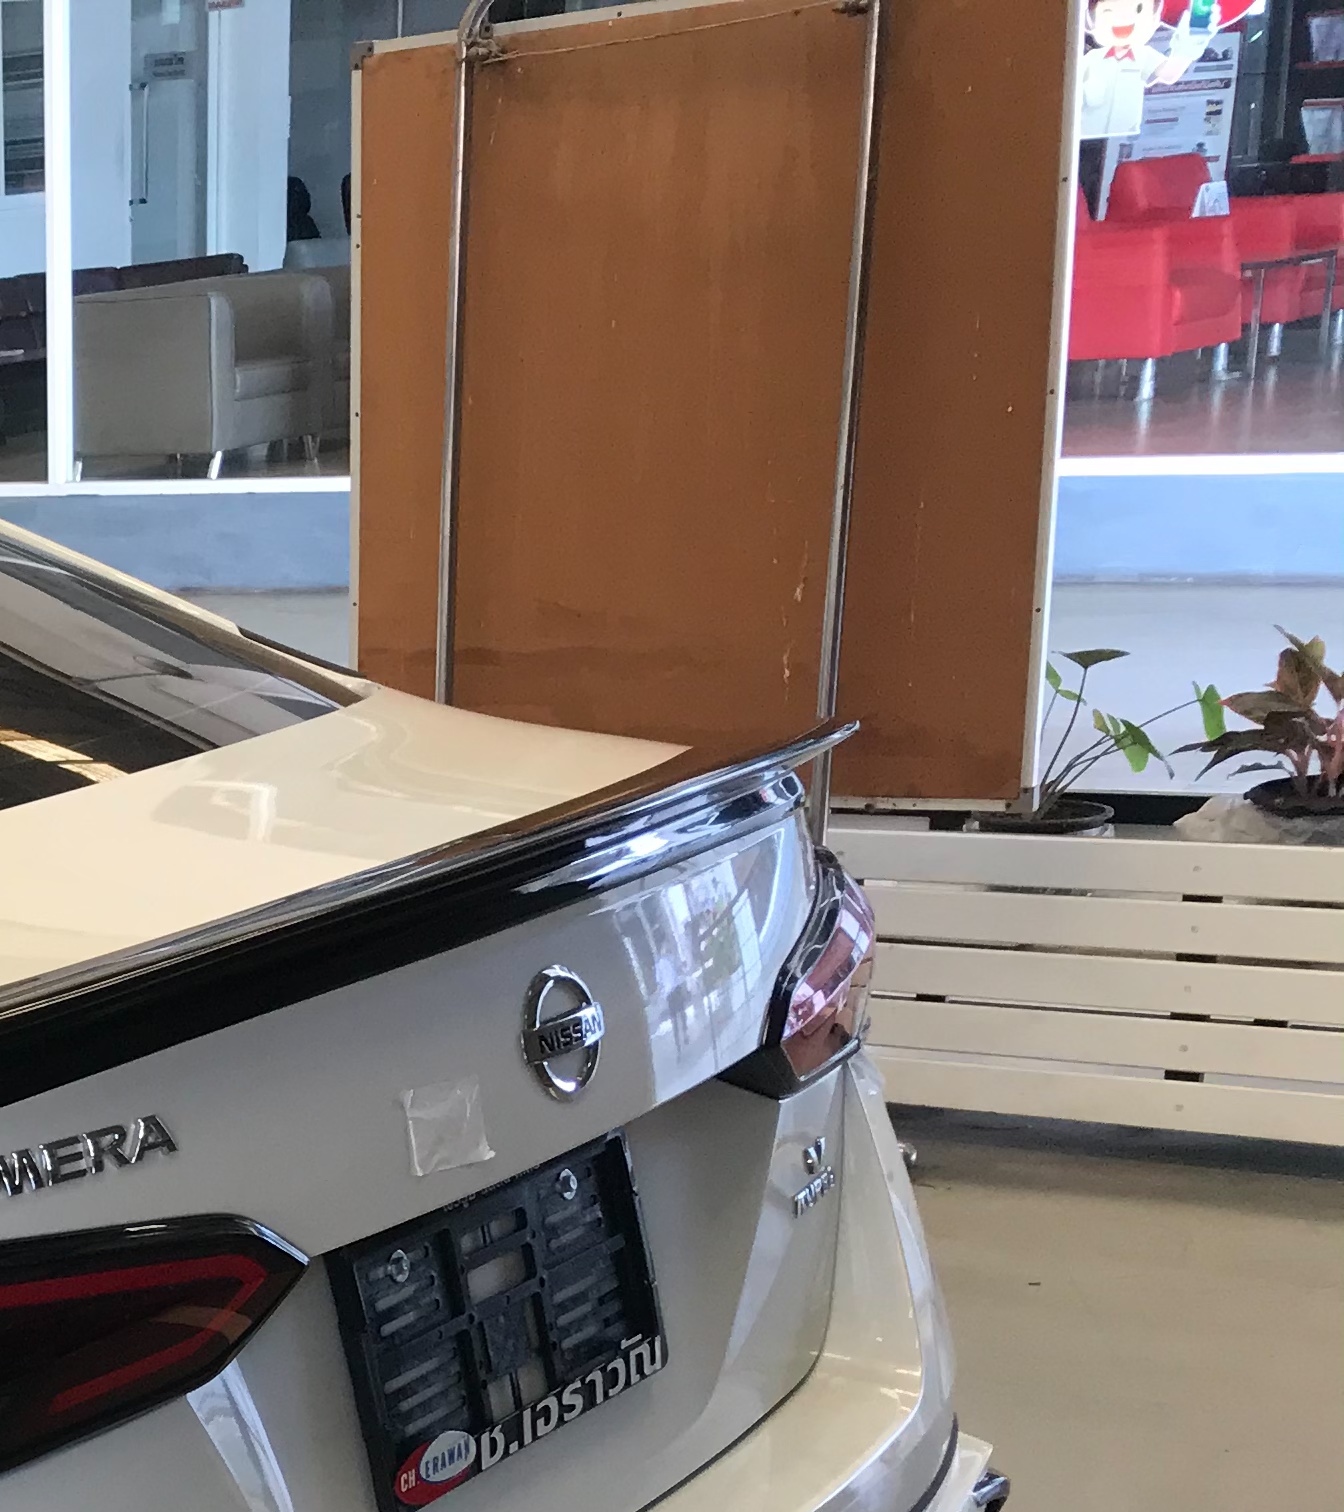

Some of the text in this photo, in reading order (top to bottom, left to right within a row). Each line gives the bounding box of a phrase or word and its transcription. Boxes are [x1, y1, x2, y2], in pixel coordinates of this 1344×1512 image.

[538, 1003, 603, 1055] NISSAN
[479, 1333, 662, 1471] ช.เอราวัณ
[424, 1434, 471, 1480] ERAWAN
